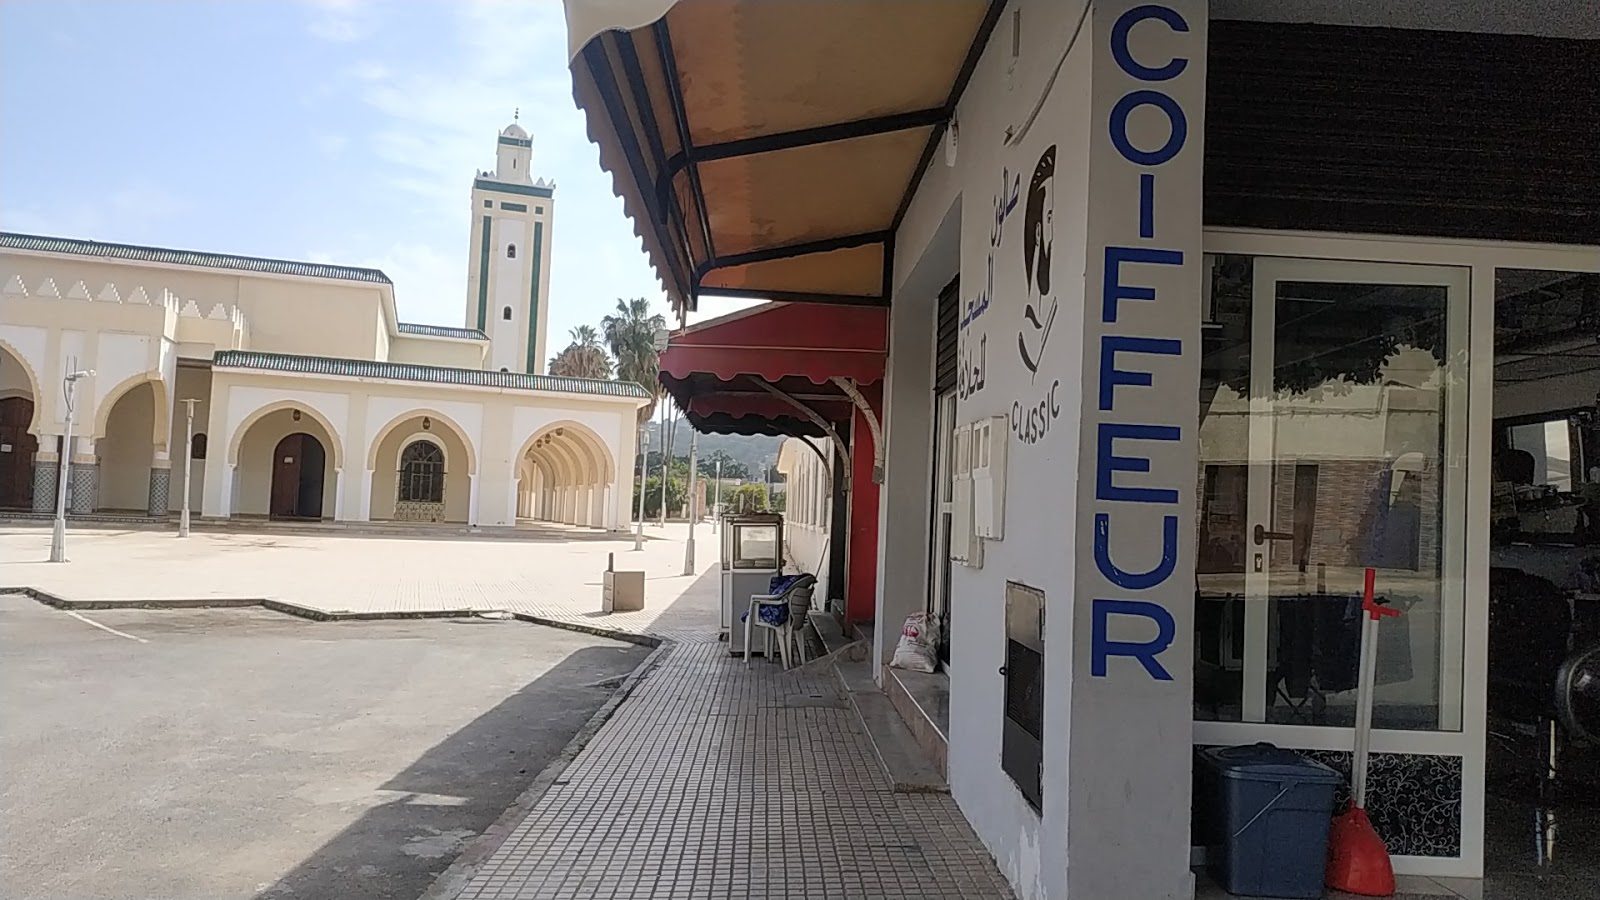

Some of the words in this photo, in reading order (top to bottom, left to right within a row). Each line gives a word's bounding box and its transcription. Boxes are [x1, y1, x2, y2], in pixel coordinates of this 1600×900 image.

[990, 166, 1020, 247] صالون
[960, 252, 994, 336] المسجد
[958, 332, 987, 400] للحلاقة
[1091, 4, 1189, 681] COIFFEUR
[1012, 380, 1060, 445] CLASSIC
